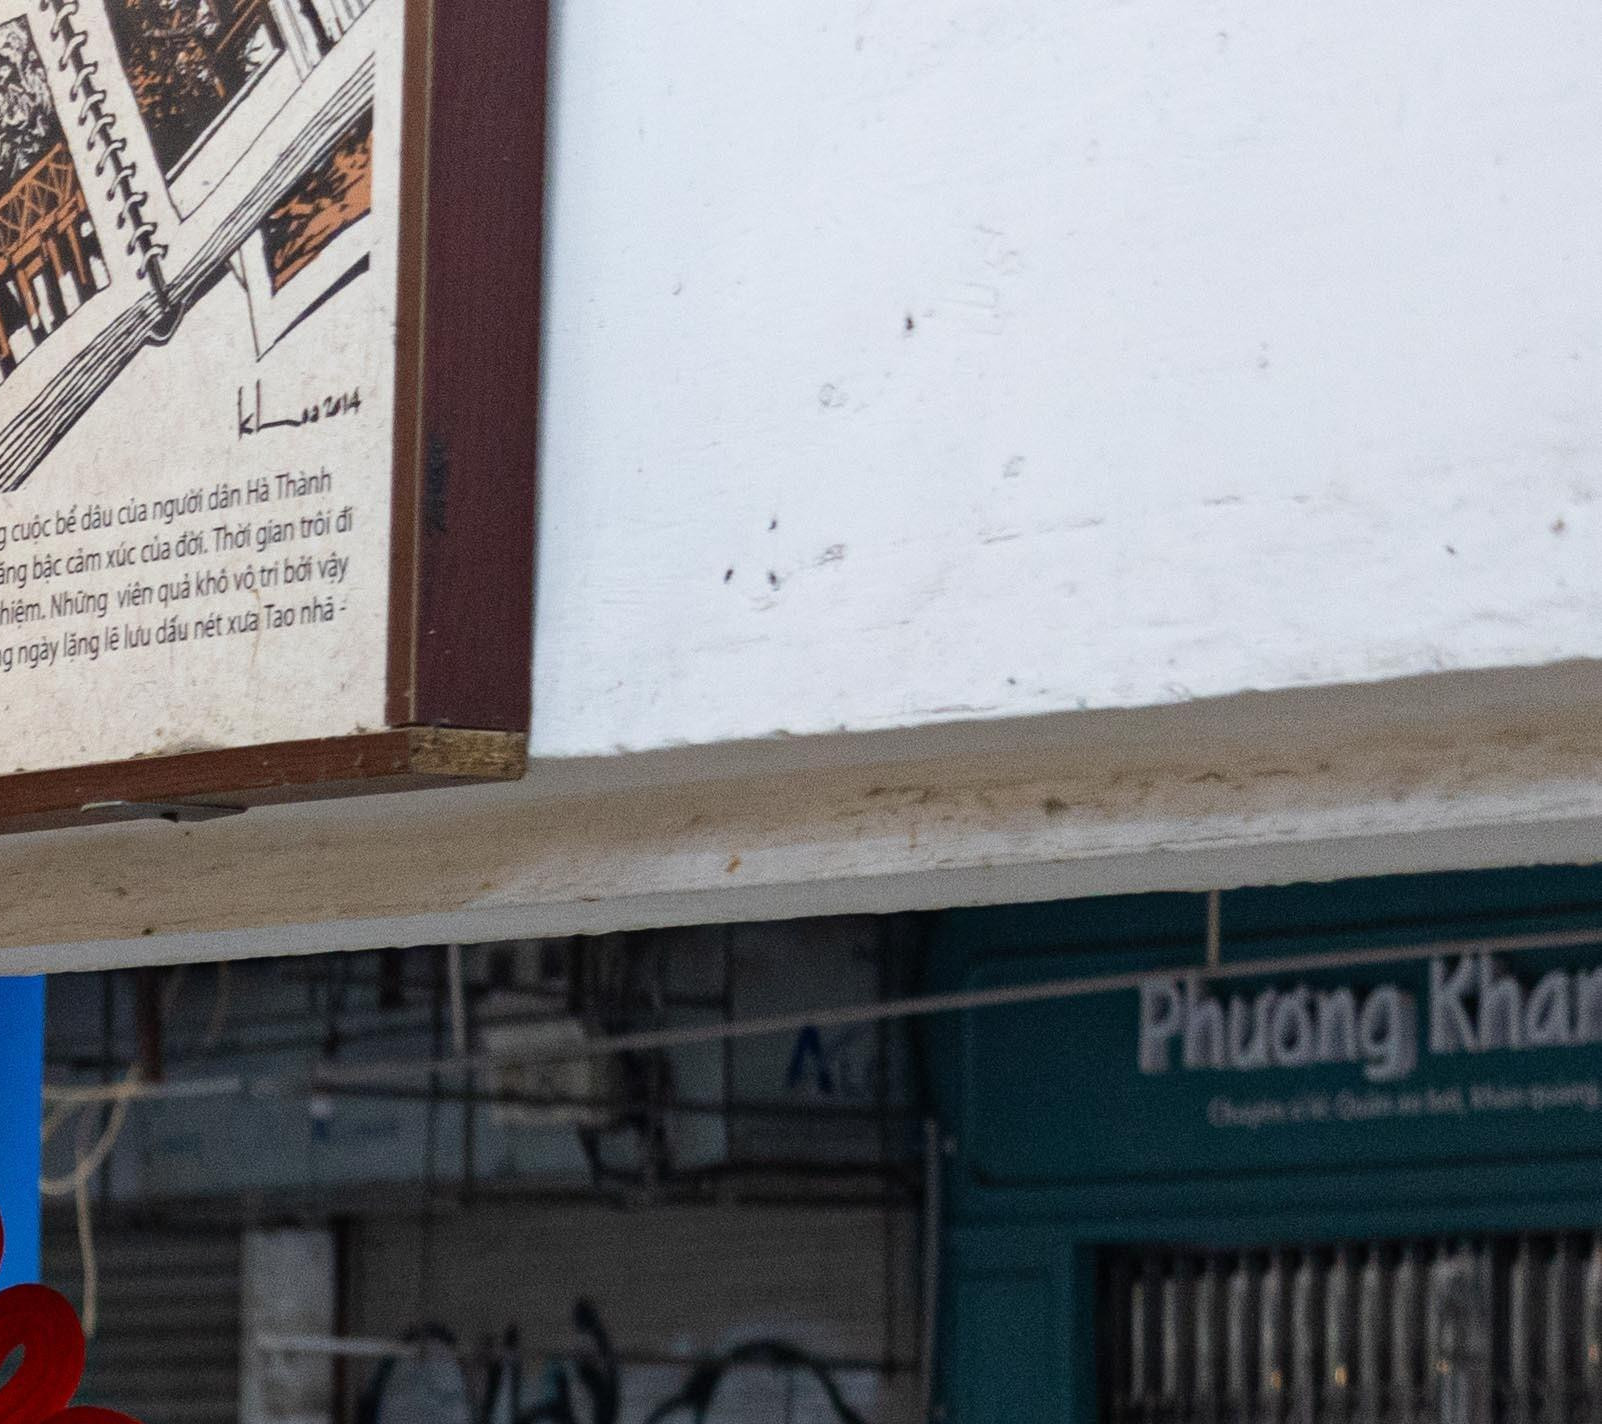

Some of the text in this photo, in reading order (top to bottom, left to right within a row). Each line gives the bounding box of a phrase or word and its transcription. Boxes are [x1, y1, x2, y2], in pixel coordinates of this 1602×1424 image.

[10, 513, 52, 545] cuộc
[80, 503, 113, 531] dâu
[116, 497, 148, 526] của
[152, 487, 204, 525] người
[207, 482, 242, 511] dân
[245, 476, 270, 505] Hà
[276, 466, 332, 500] Thành
[32, 552, 63, 584] bậc
[64, 547, 102, 575] cảm
[104, 540, 137, 569] xúc
[140, 534, 172, 564] của
[255, 518, 296, 553] gian
[298, 509, 332, 539] trôi
[334, 505, 354, 534] đi
[50, 589, 109, 619] Những
[116, 580, 154, 609] viên
[157, 572, 191, 609] quả
[194, 566, 230, 597] khô
[233, 568, 255, 596] vô
[258, 567, 279, 593] tri
[282, 554, 313, 585] bởi
[317, 550, 349, 584] vậy
[17, 635, 60, 670] ngày
[62, 631, 100, 663] lặng
[123, 623, 152, 650] lưu
[154, 614, 189, 645] dấu
[193, 611, 223, 640] nét
[225, 610, 261, 636] xưa
[262, 603, 296, 629] Tao
[1139, 975, 1418, 1083] Phương
